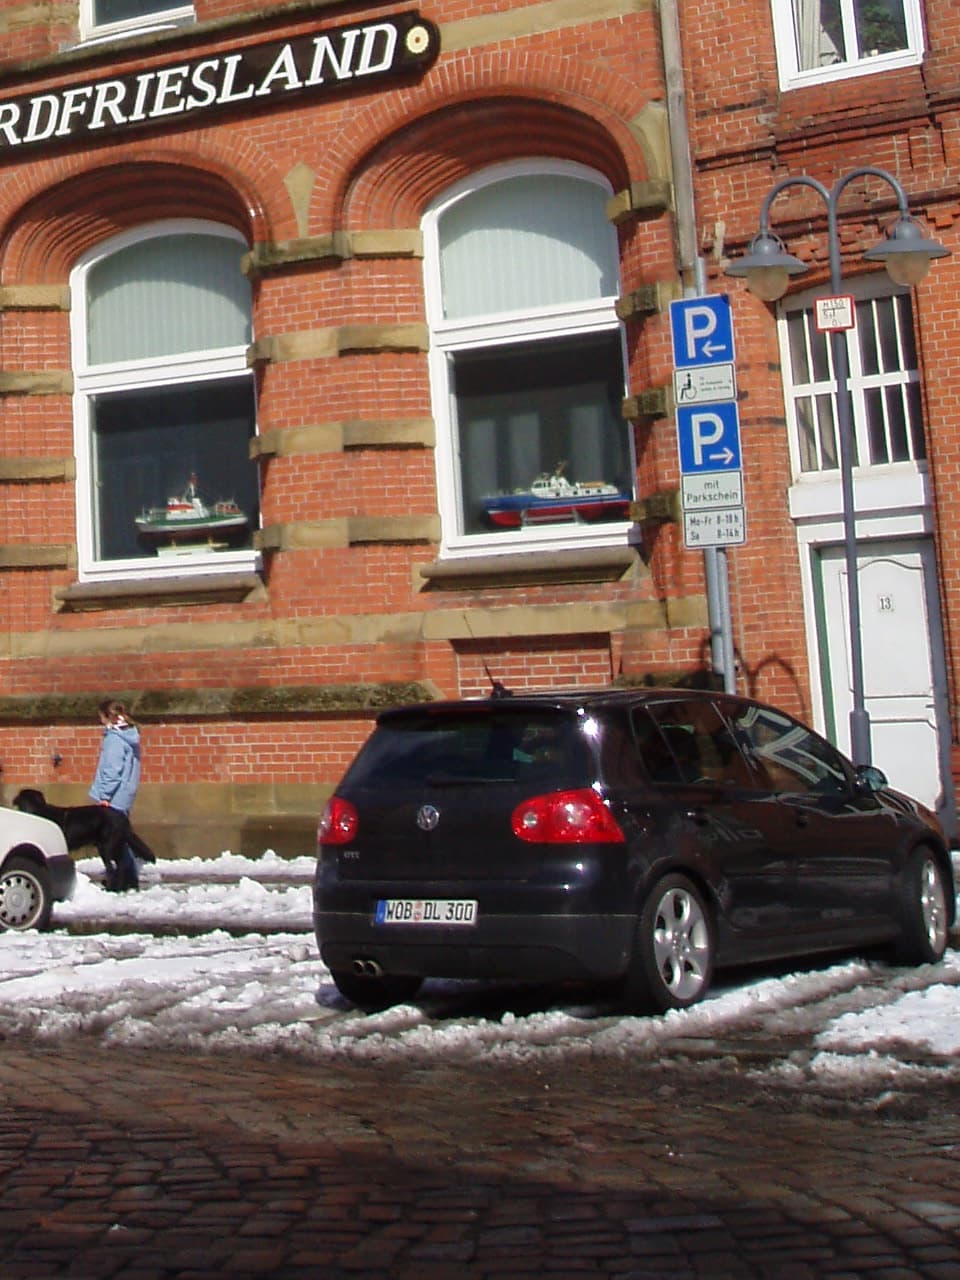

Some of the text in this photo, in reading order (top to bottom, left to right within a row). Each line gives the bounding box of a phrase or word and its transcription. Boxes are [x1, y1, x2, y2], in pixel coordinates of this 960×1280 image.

[684, 306, 717, 359] P
[691, 412, 724, 466] P
[703, 479, 720, 490] mit
[686, 489, 739, 504] Parkschein
[880, 597, 892, 610] 13
[386, 902, 474, 921] WOB DL 300
